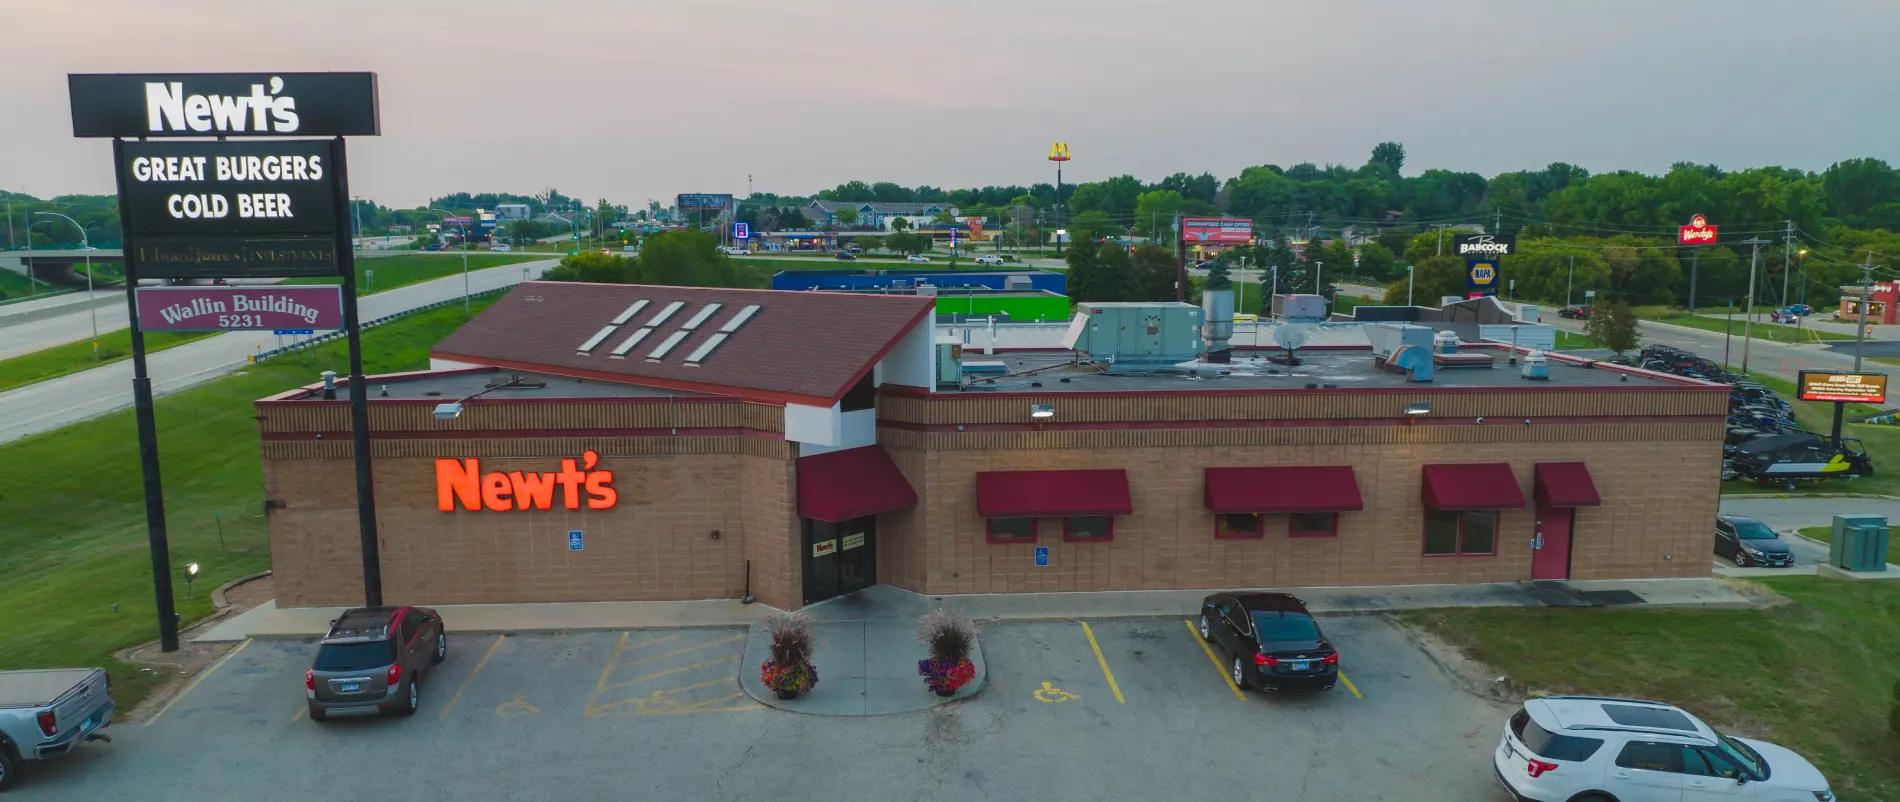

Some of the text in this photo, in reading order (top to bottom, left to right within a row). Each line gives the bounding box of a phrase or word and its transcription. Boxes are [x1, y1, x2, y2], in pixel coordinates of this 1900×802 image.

[145, 76, 300, 132] Newt's
[132, 155, 323, 181] GREAT BURGERS
[168, 193, 294, 218] COLD BEER
[1684, 227, 1714, 241] Wendy's
[1460, 243, 1508, 254] BABCOCK
[1475, 268, 1491, 279] NAPA
[159, 294, 319, 325] Wallin Building
[219, 314, 264, 328] 5231
[435, 450, 618, 512] Newt's
[816, 540, 833, 552] Newt's
